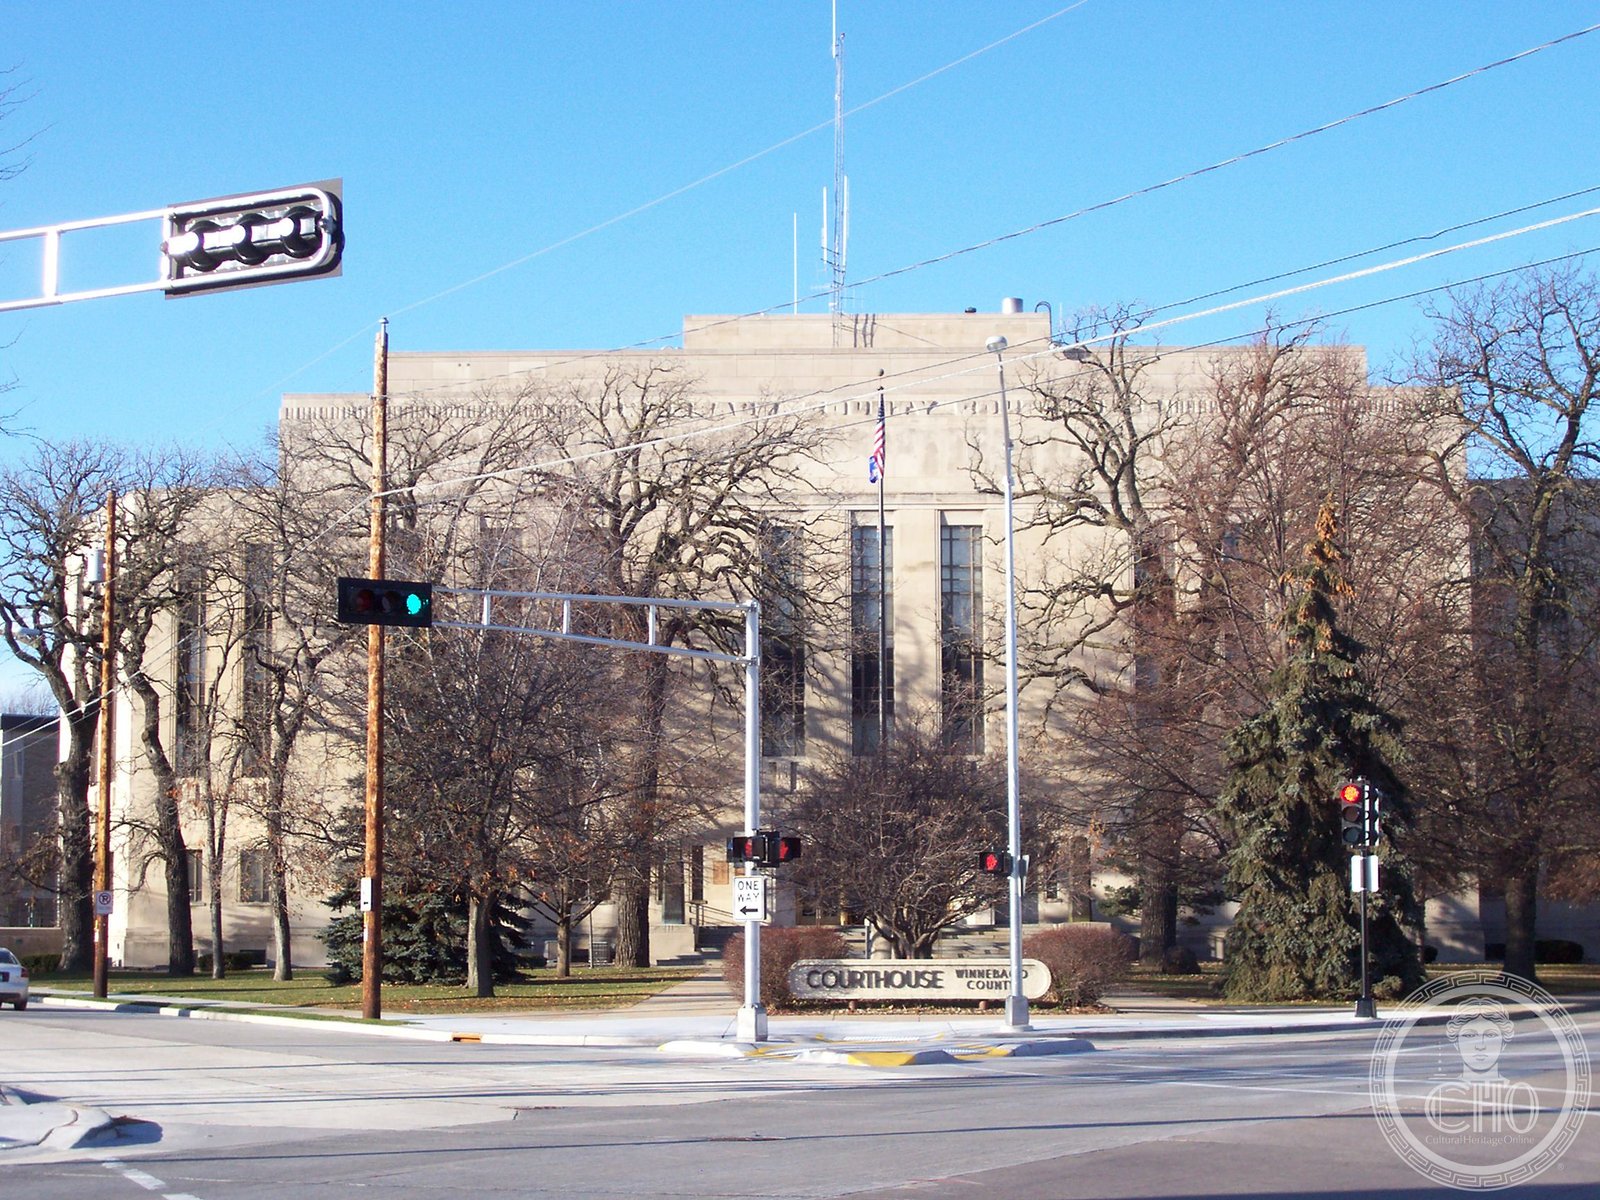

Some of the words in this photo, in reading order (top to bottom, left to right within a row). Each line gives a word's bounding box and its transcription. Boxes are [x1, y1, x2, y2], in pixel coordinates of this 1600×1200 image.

[737, 881, 759, 890] ONE
[738, 893, 759, 902] WAY
[955, 969, 1028, 979] WINNEBAO
[807, 970, 944, 989] COURTHOUSE
[966, 980, 1012, 990] COUNT
